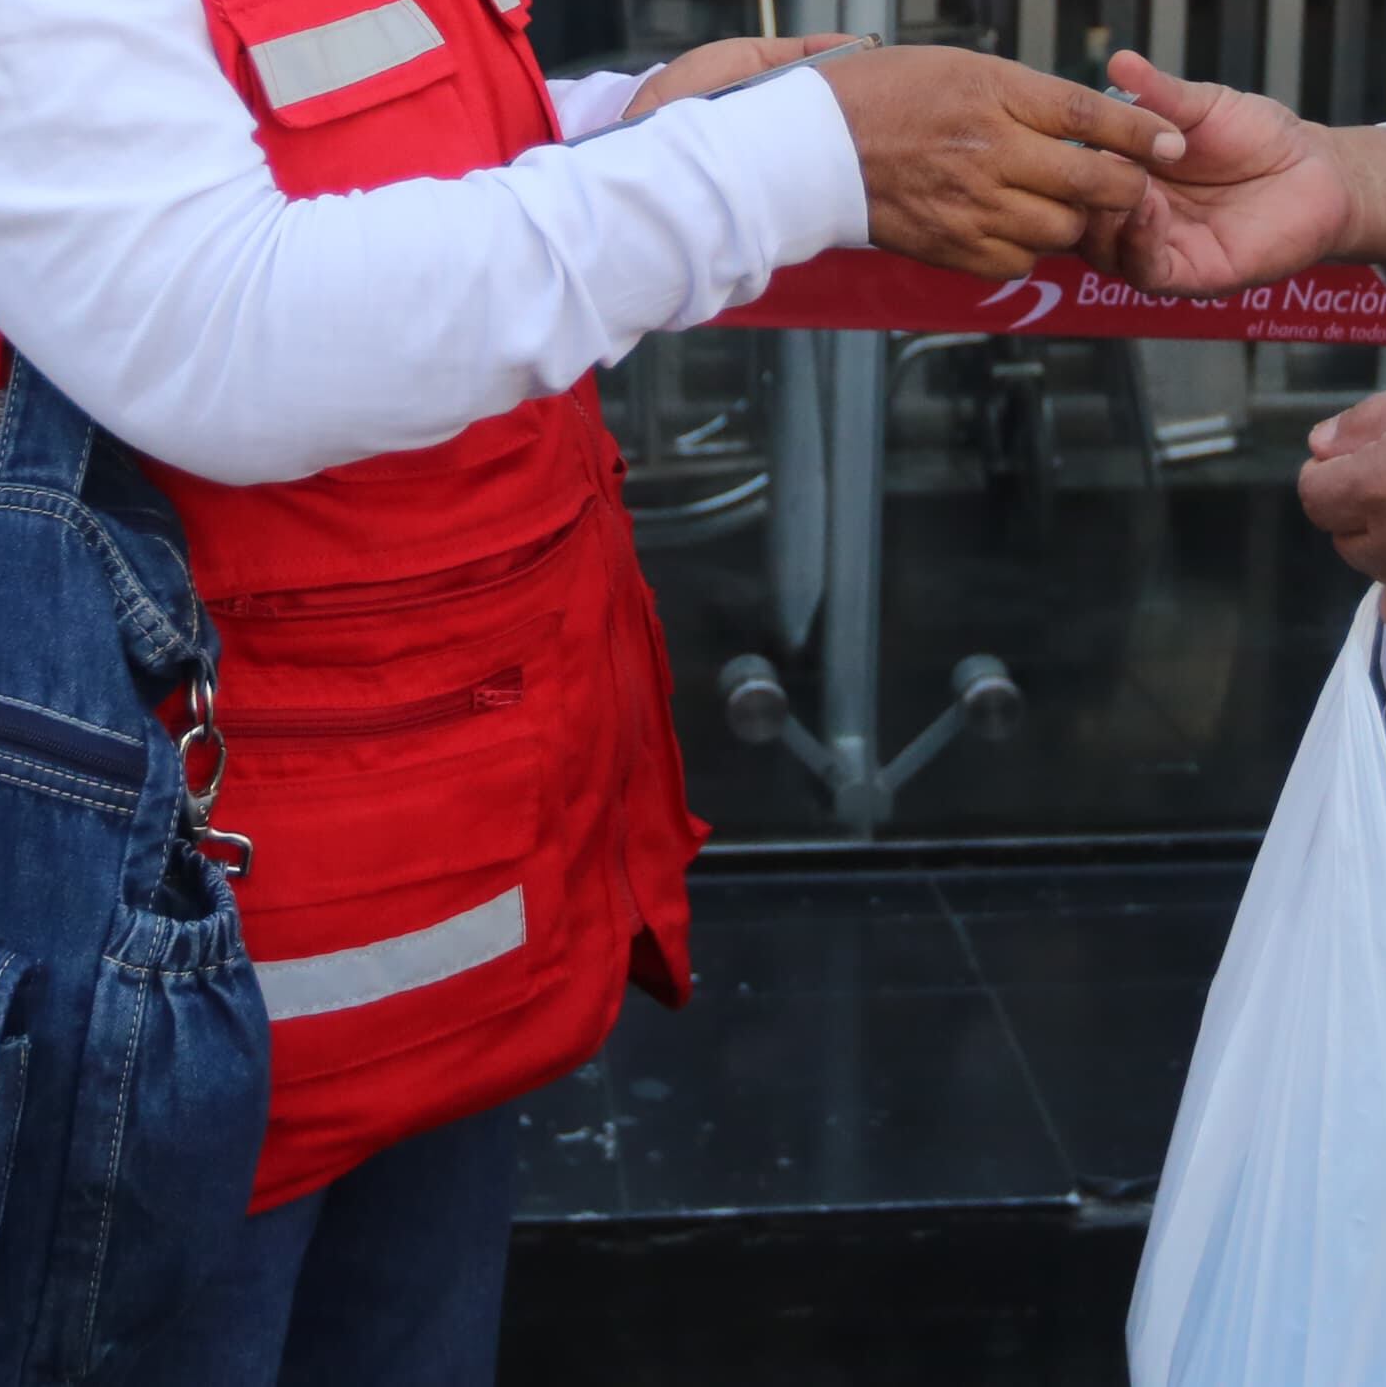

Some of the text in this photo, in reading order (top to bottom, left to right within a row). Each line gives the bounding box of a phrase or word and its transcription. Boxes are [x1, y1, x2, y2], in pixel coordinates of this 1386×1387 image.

[1246, 319, 1265, 336] el
[1267, 319, 1319, 339] banco
[1322, 321, 1346, 340] de
